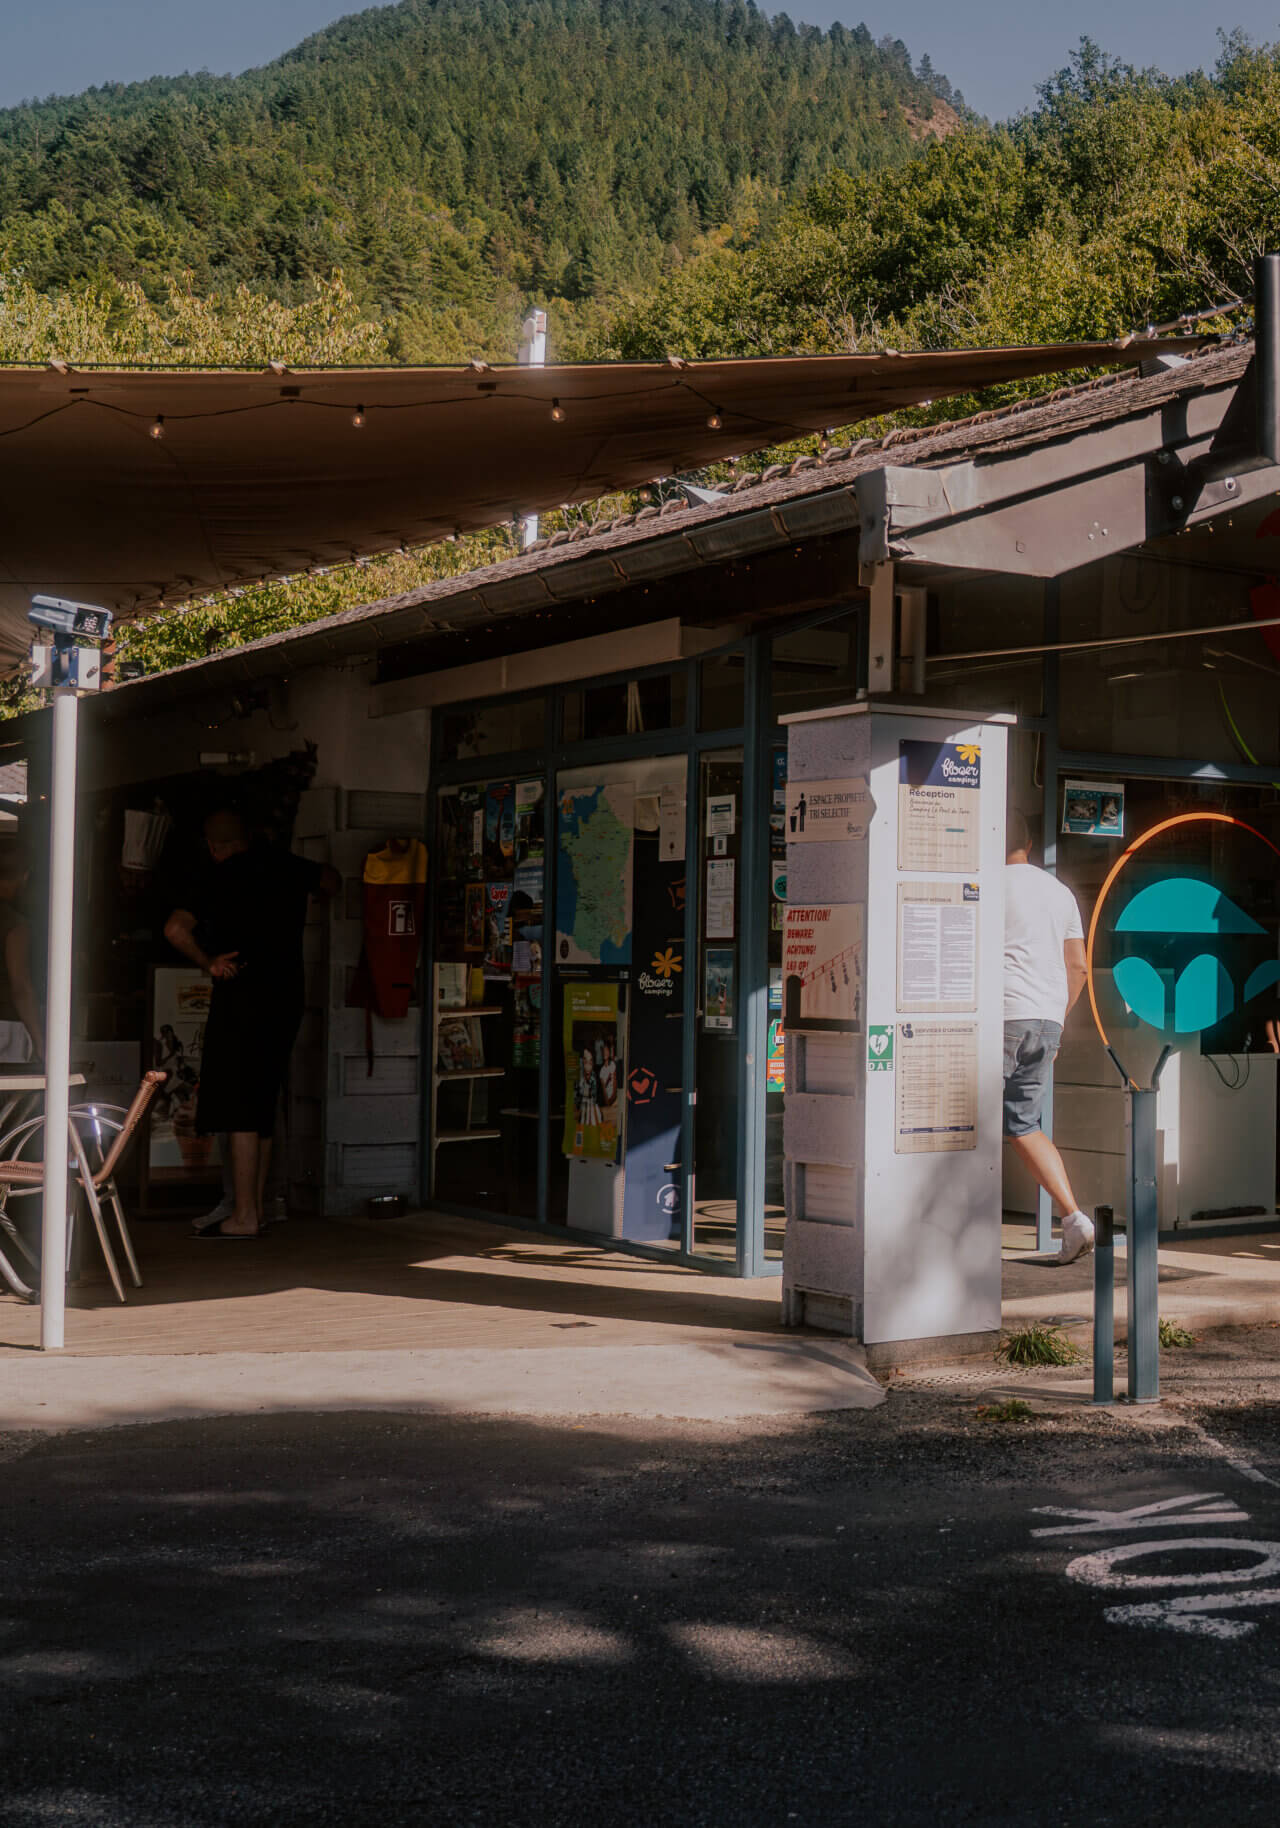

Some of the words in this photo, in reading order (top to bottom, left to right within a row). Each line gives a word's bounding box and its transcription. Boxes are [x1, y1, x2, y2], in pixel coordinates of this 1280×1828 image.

[942, 758, 980, 778] flower
[947, 776, 979, 786] campings
[787, 909, 831, 922] ATTENTION!
[787, 928, 814, 939] BEWARE!
[638, 971, 674, 990] flower
[644, 988, 673, 997] campings
